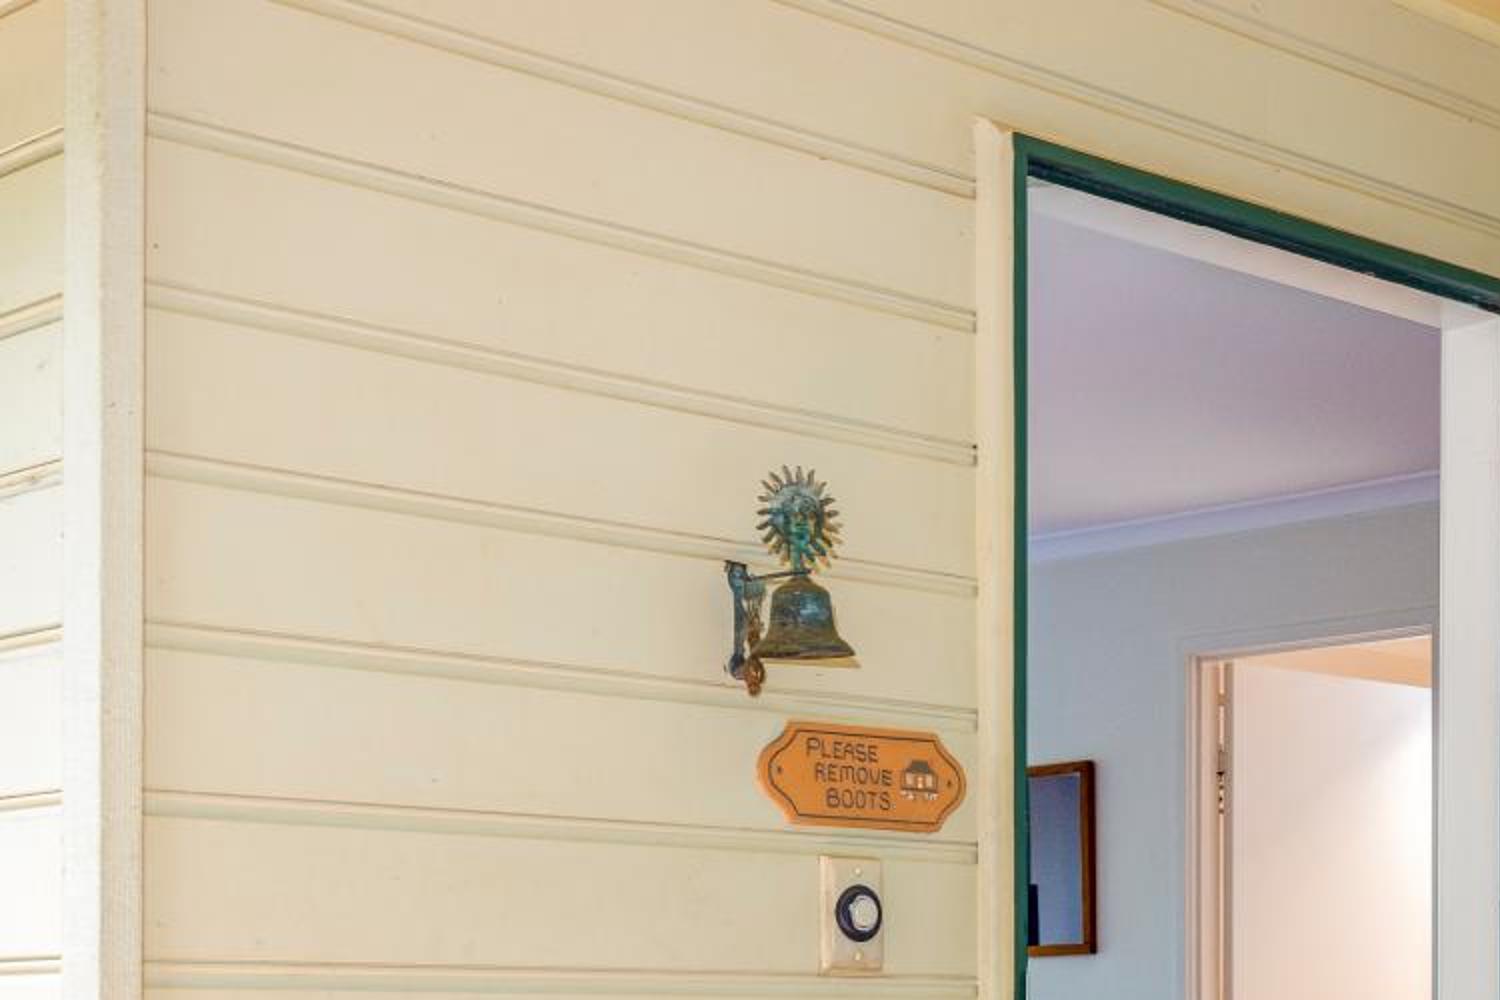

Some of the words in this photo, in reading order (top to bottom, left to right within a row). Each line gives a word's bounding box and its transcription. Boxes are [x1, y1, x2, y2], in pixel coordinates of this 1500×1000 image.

[806, 737, 878, 762] PLEASE
[815, 762, 892, 786] REMOVE
[827, 788, 891, 810] BOOTS
